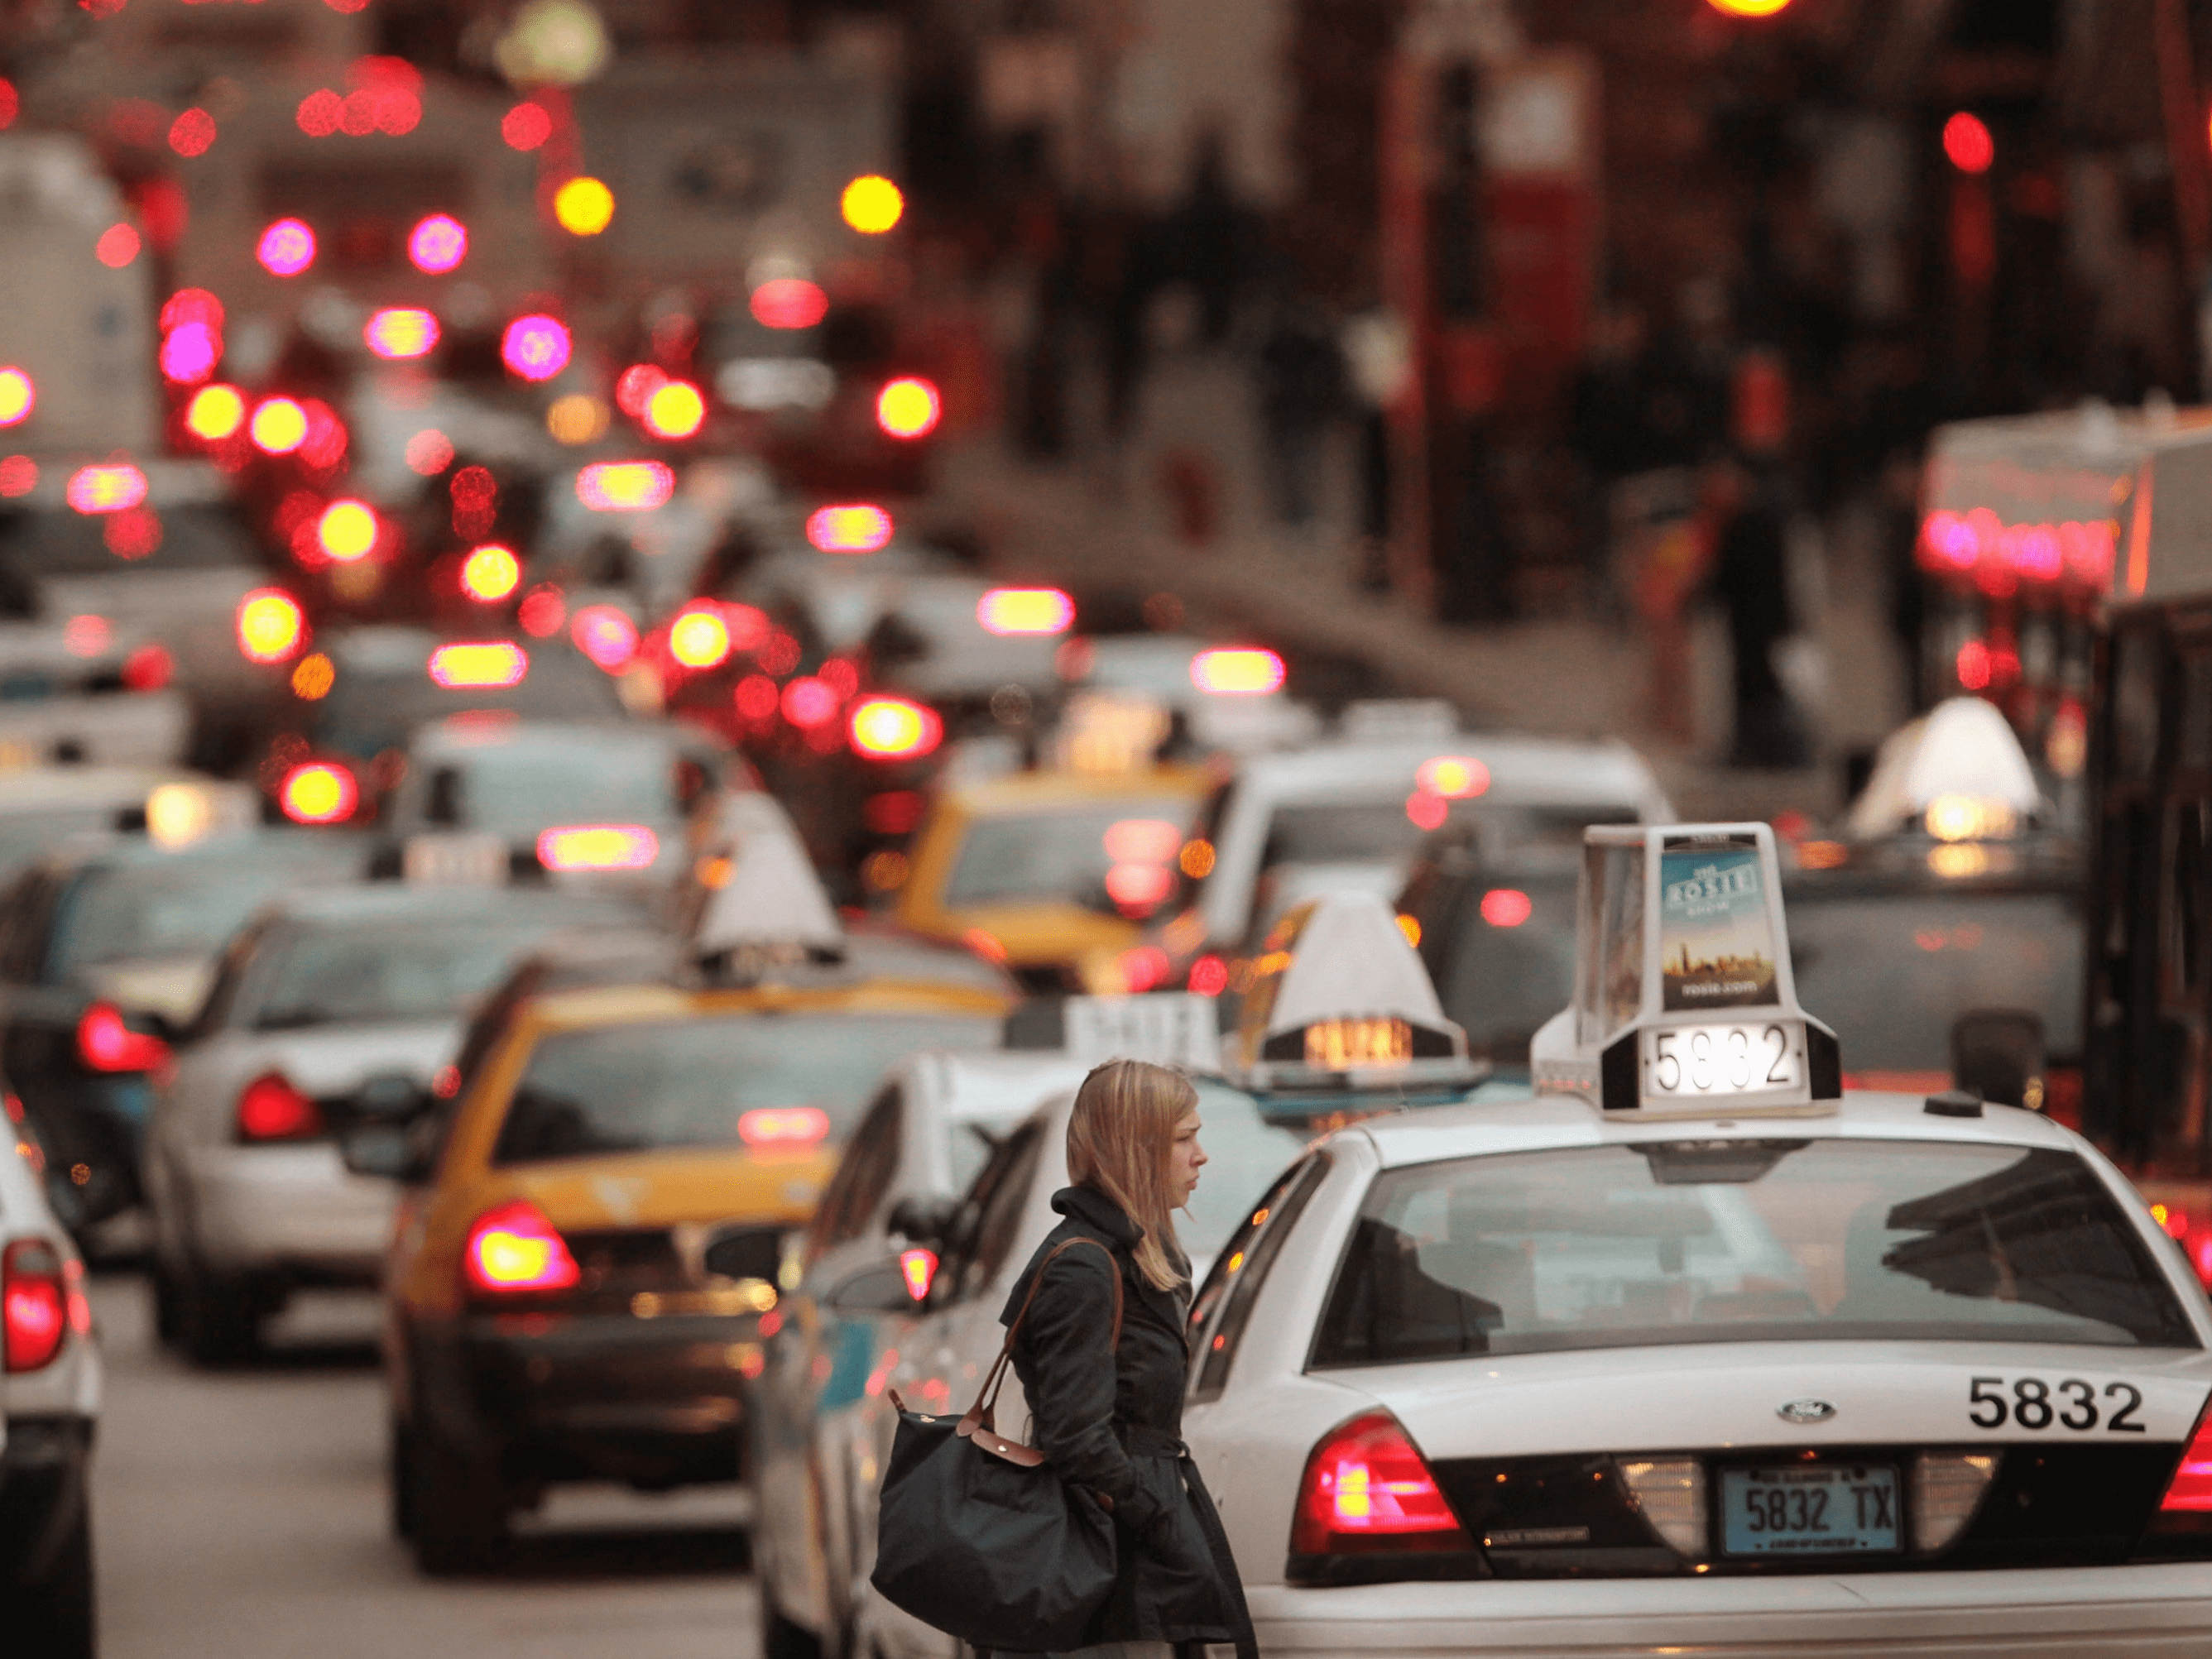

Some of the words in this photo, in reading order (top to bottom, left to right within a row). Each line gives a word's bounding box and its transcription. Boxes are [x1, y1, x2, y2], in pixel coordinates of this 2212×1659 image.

[1657, 1024, 1790, 1091] 5832
[1969, 1376, 2146, 1432] 5832
[1746, 1488, 1831, 1531] 5832
[1850, 1485, 1893, 1529] TX
